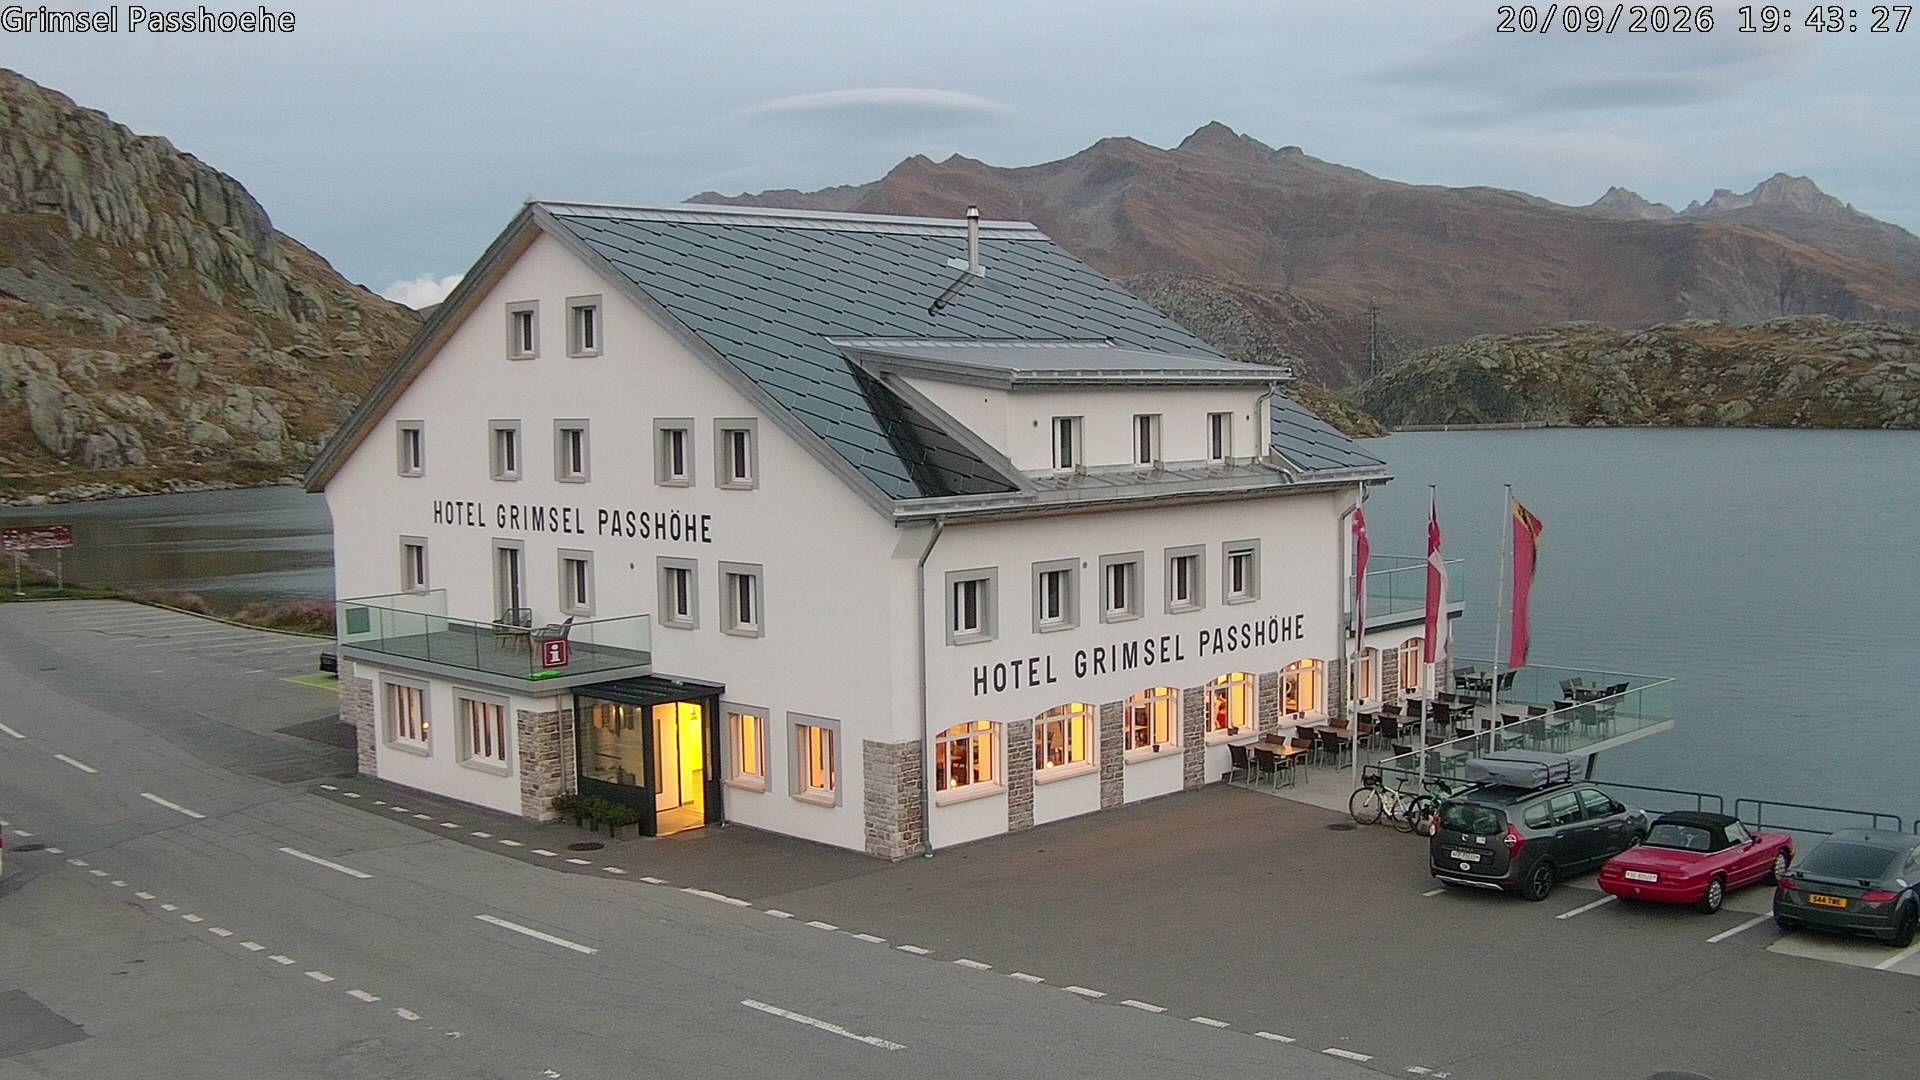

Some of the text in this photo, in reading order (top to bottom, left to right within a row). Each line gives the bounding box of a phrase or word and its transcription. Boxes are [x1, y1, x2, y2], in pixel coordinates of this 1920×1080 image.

[433, 500, 712, 543] HOTEL GRIMSEL PASSHÖHE
[973, 614, 1304, 696] HOTEL GRIMSEL PASSHÖHE
